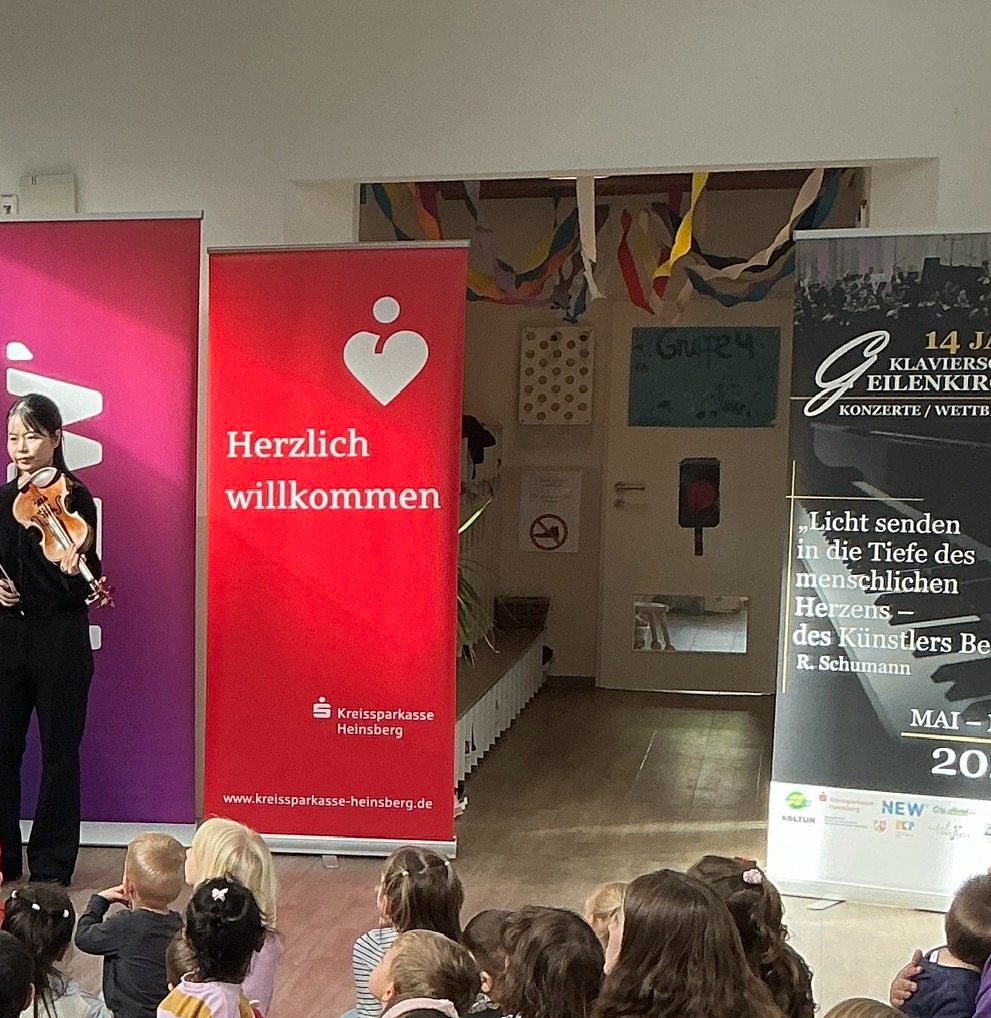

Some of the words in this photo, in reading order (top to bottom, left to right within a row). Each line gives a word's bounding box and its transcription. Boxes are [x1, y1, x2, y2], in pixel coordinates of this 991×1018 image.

[925, 330, 961, 354] 14
[889, 357, 991, 371] KLAVIERS
[866, 374, 991, 392] EILENKIR
[839, 404, 922, 416] KONZERTE
[934, 405, 991, 416] WETTB
[226, 428, 370, 458] Herzlich
[225, 480, 442, 510] willkommen
[798, 510, 869, 534] „Licht
[875, 513, 961, 535] senden
[796, 538, 818, 560] in
[826, 539, 862, 561] die
[868, 541, 928, 563] Tiefe
[934, 543, 976, 565] des
[795, 569, 959, 595] menschlichen
[794, 596, 891, 619] Herzens
[793, 624, 832, 647] des
[837, 627, 952, 652] Künstlers
[959, 633, 991, 655] Be
[796, 655, 815, 670] R.
[819, 655, 912, 676] Schumann
[337, 707, 435, 722] Kreissparkasse
[910, 708, 960, 730] MAI
[337, 723, 404, 739] Heinsberg
[931, 747, 991, 779] 20
[223, 793, 433, 811] www.kreissparkasse-heinsberg.de
[881, 800, 925, 817] NEW
